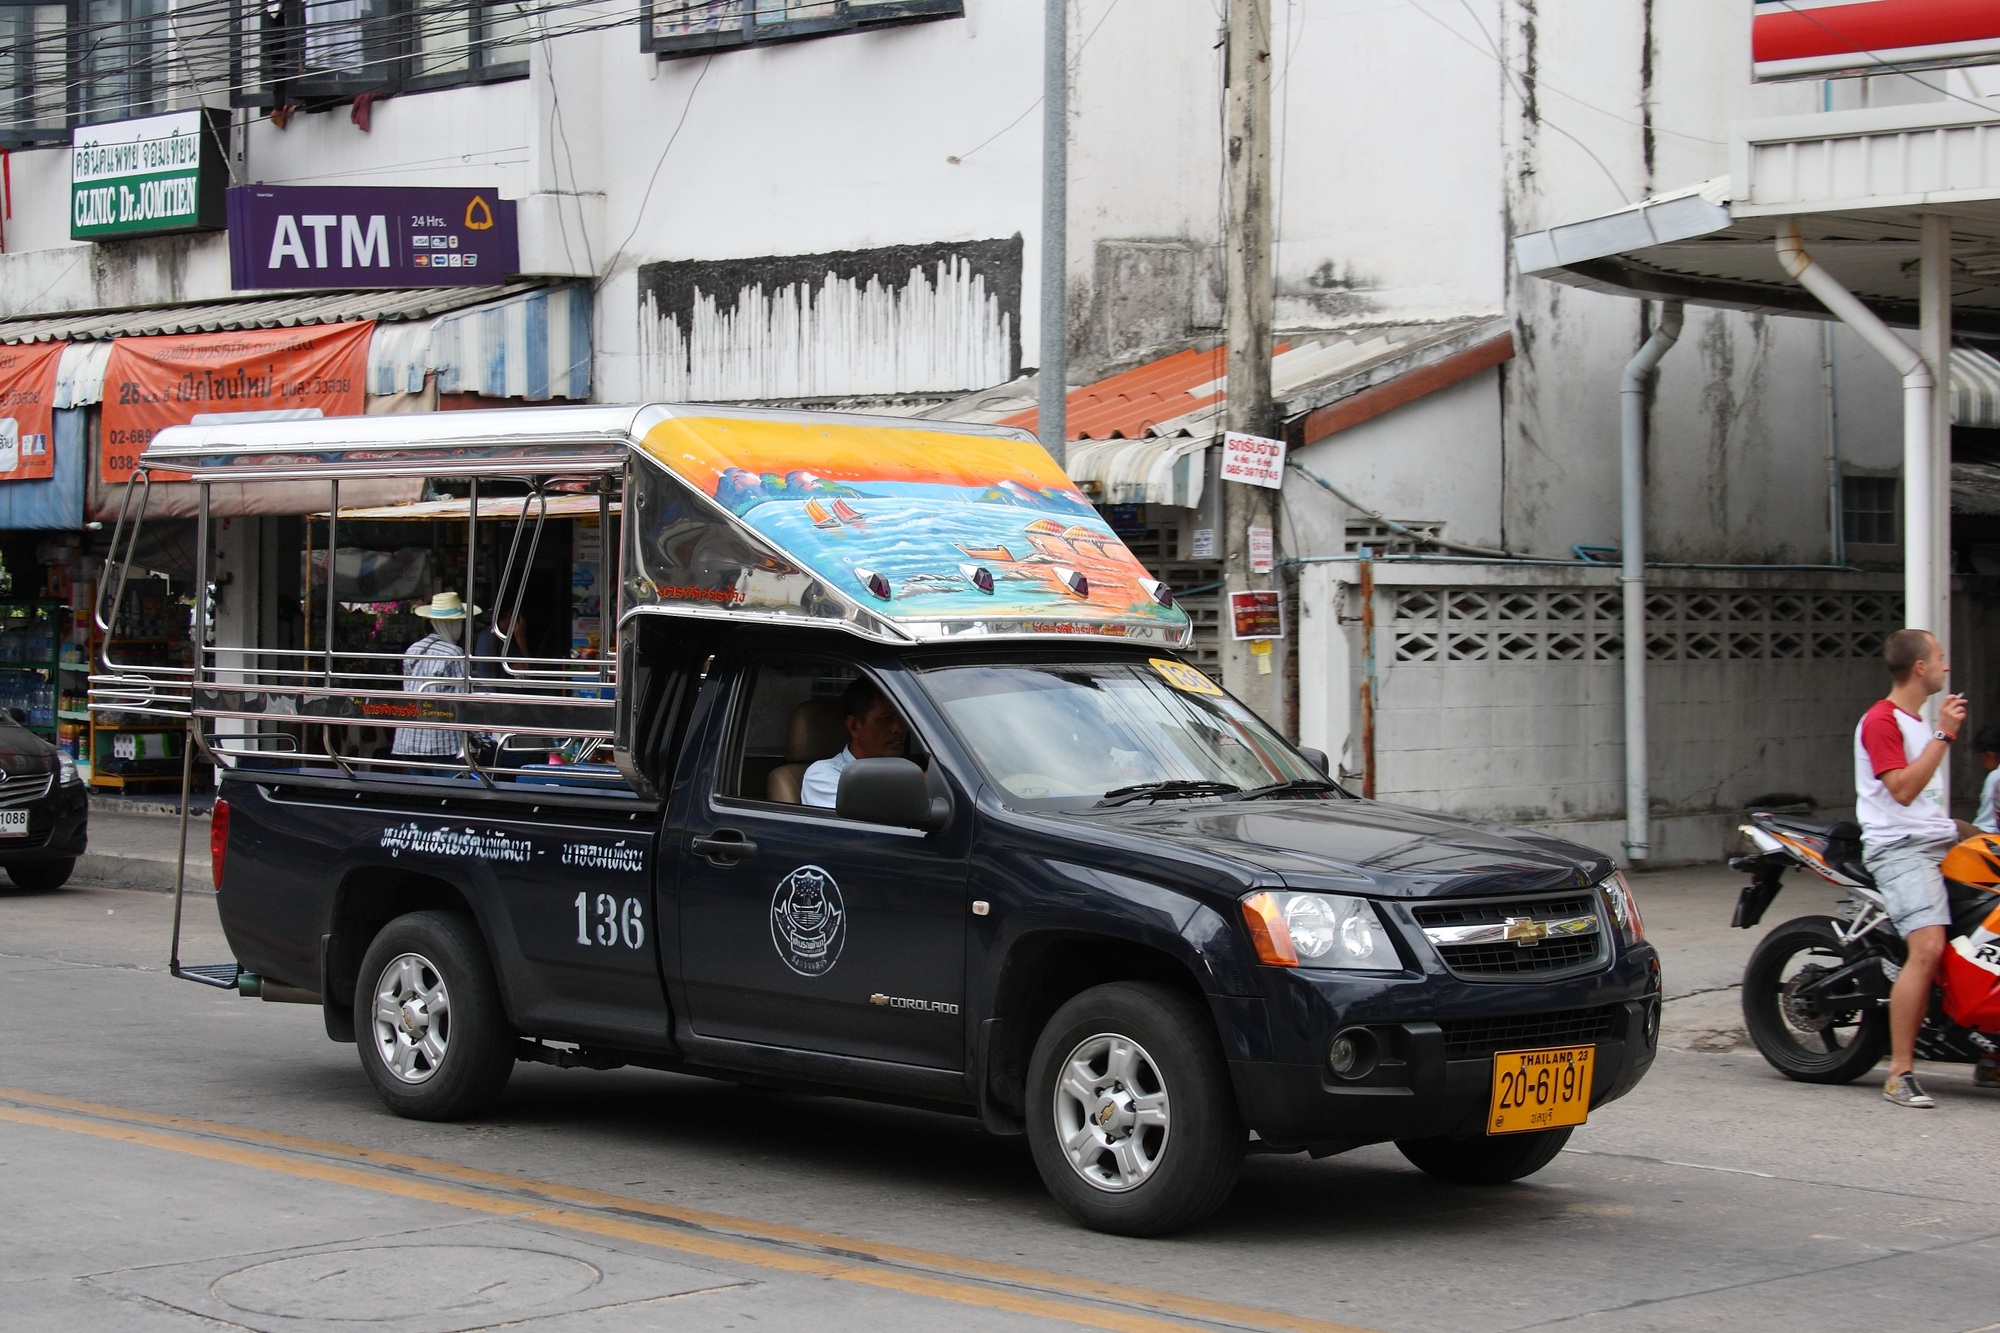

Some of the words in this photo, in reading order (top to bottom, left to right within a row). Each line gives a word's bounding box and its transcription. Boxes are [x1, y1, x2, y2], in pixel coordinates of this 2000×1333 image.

[76, 133, 141, 178] คลินิคแพทย์
[142, 126, 198, 169] จอมเทียน
[74, 186, 116, 228] CLINIC
[119, 176, 197, 222] Dr.JOMTIEN
[411, 215, 425, 227] 24
[426, 215, 447, 227] Hrs.
[268, 214, 391, 270] ATM
[119, 381, 140, 405] 26
[313, 375, 351, 396] วิวสวย
[109, 428, 156, 445] 02-689
[1228, 437, 1280, 457] รถรับจ้าง
[1158, 663, 1213, 690] 136
[0, 812, 26, 825] 1088
[561, 839, 644, 872] นาจอมเทียน
[573, 891, 646, 950] 136
[889, 997, 959, 1015] COROLADO
[1520, 1052, 1573, 1066] THAILAND
[1577, 1050, 1588, 1062] 23
[1499, 1064, 1585, 1109] 20-6191
[1530, 1108, 1554, 1126] ชลบุรี
